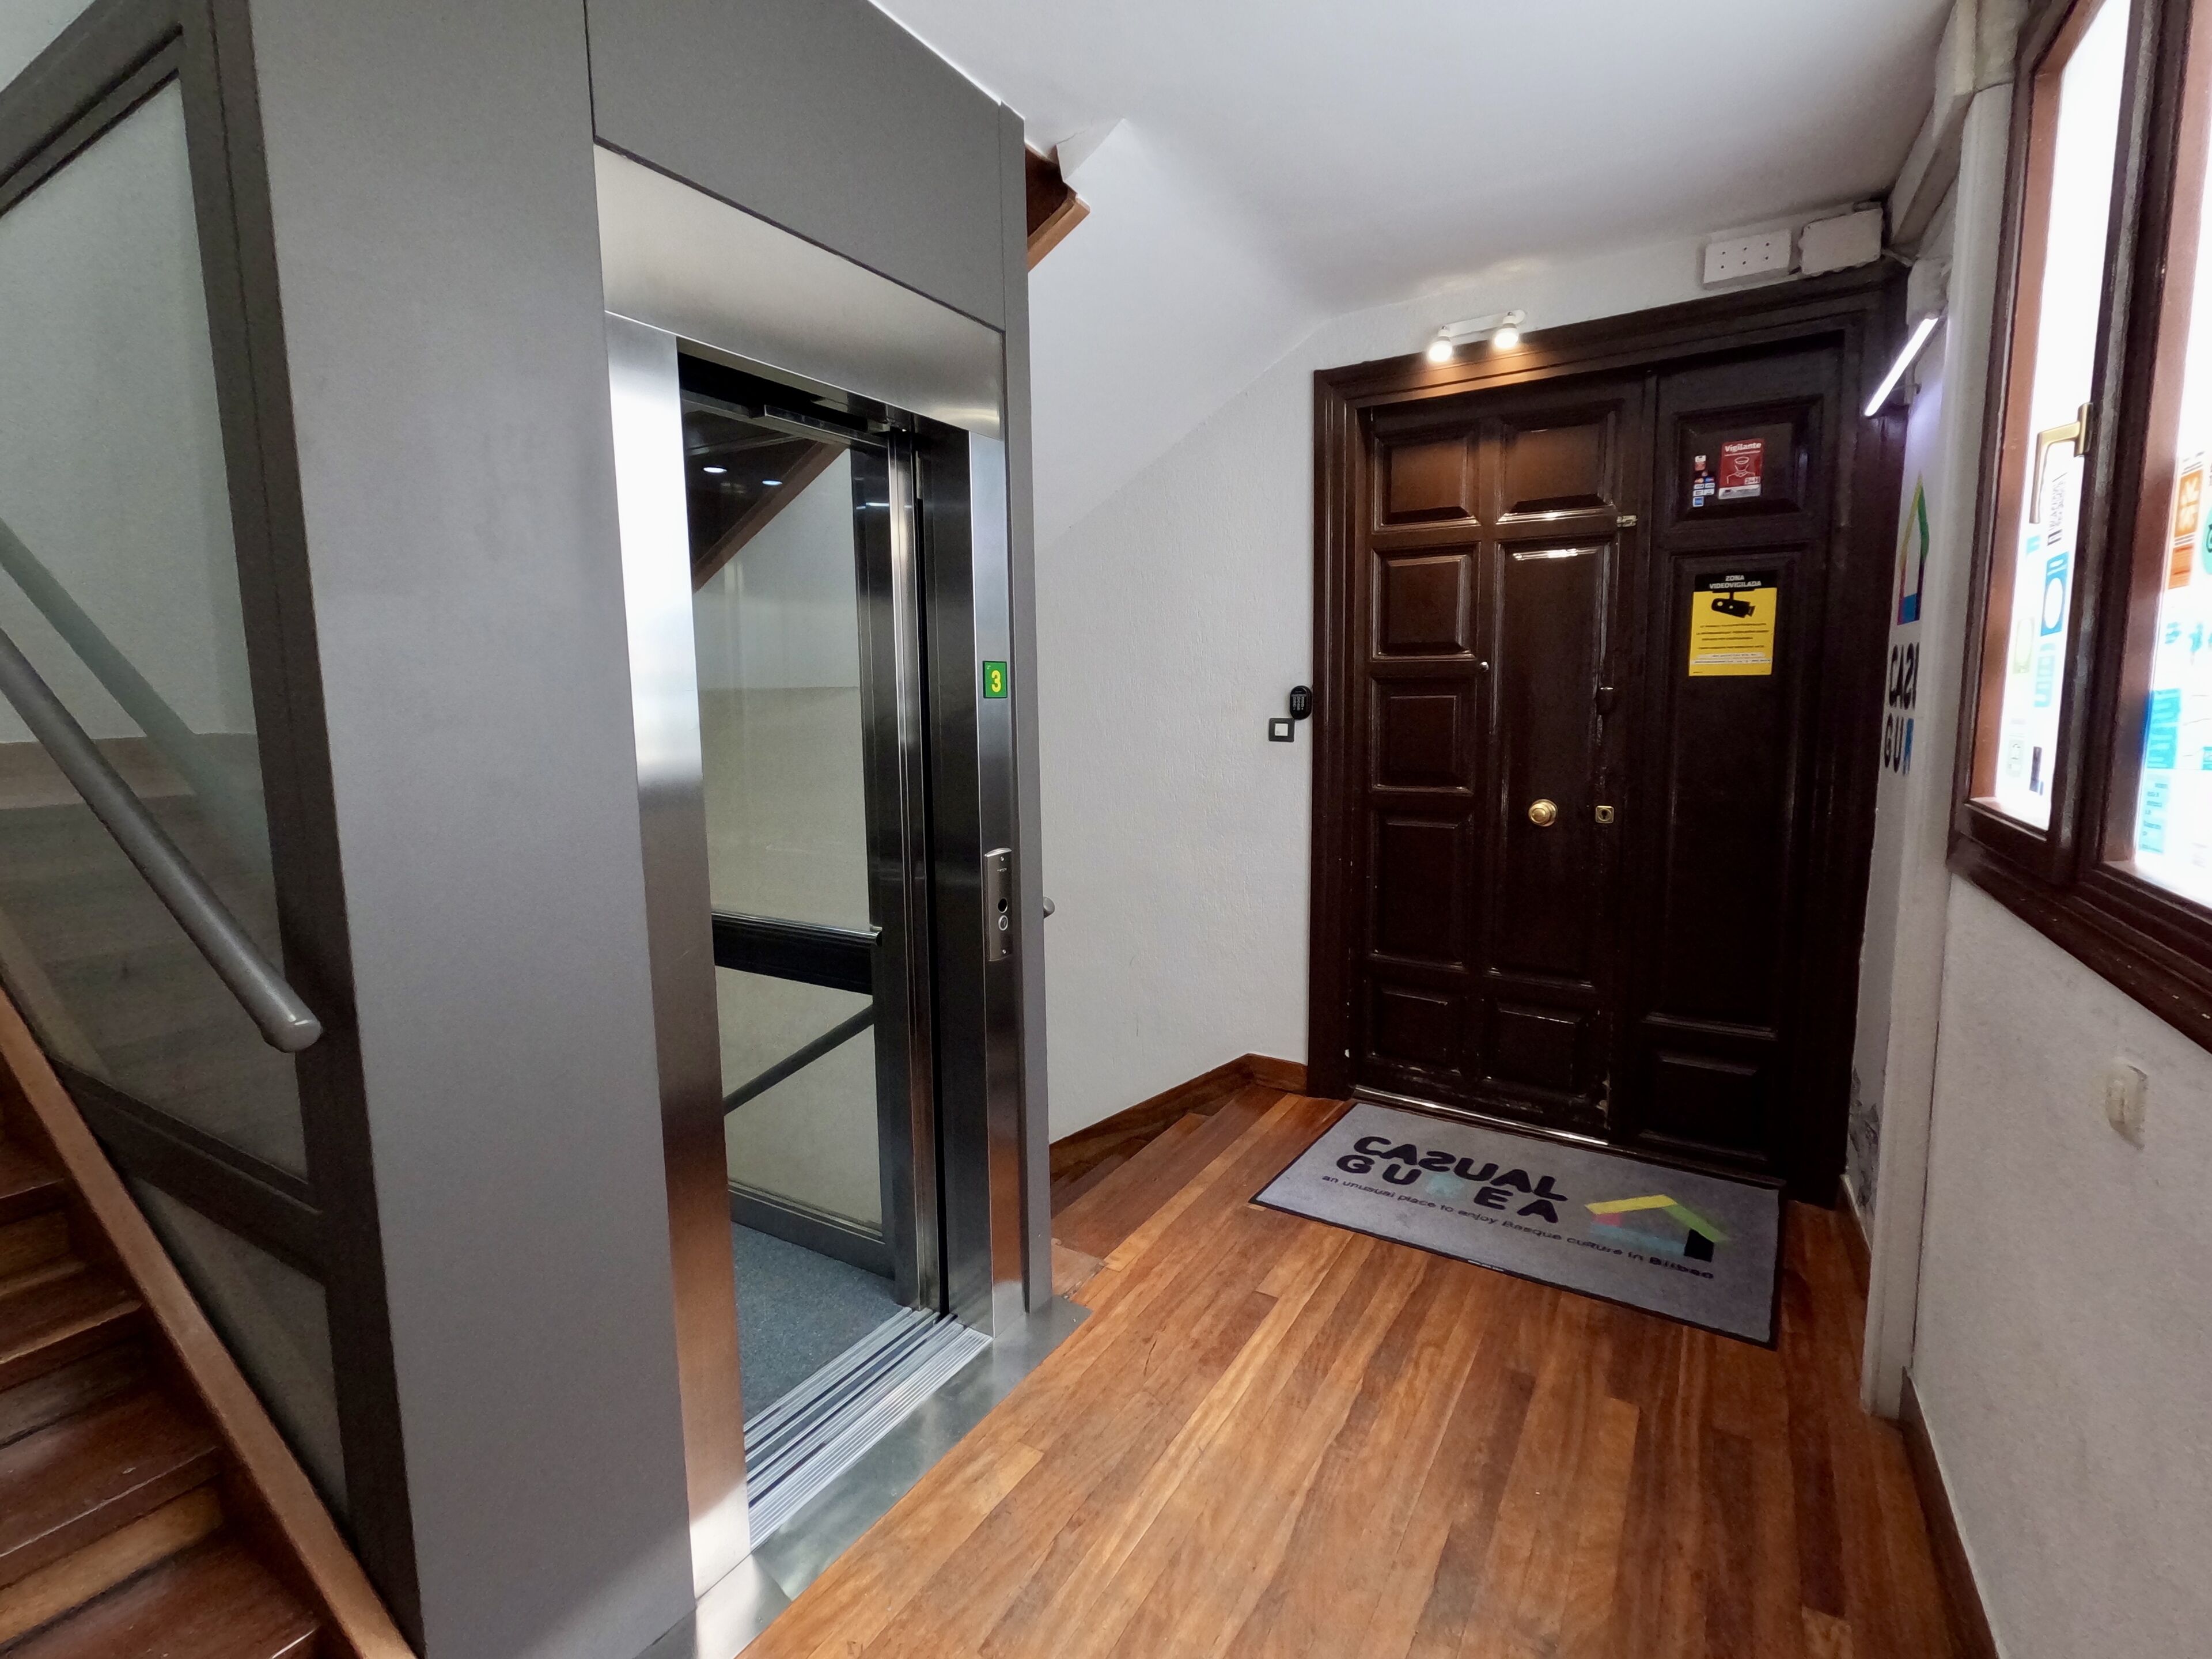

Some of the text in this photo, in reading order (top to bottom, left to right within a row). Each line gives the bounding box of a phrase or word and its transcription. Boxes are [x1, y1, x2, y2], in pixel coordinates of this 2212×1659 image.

[1725, 442, 1762, 453] Vigilante
[1709, 581, 1762, 589] VIDEOVIGILADA
[991, 669, 1002, 693] 3
[1353, 1135, 1569, 1202] CASUAL
[1321, 1175, 1714, 1279] an unusual place to enjoy Basque culture in Bilbao
